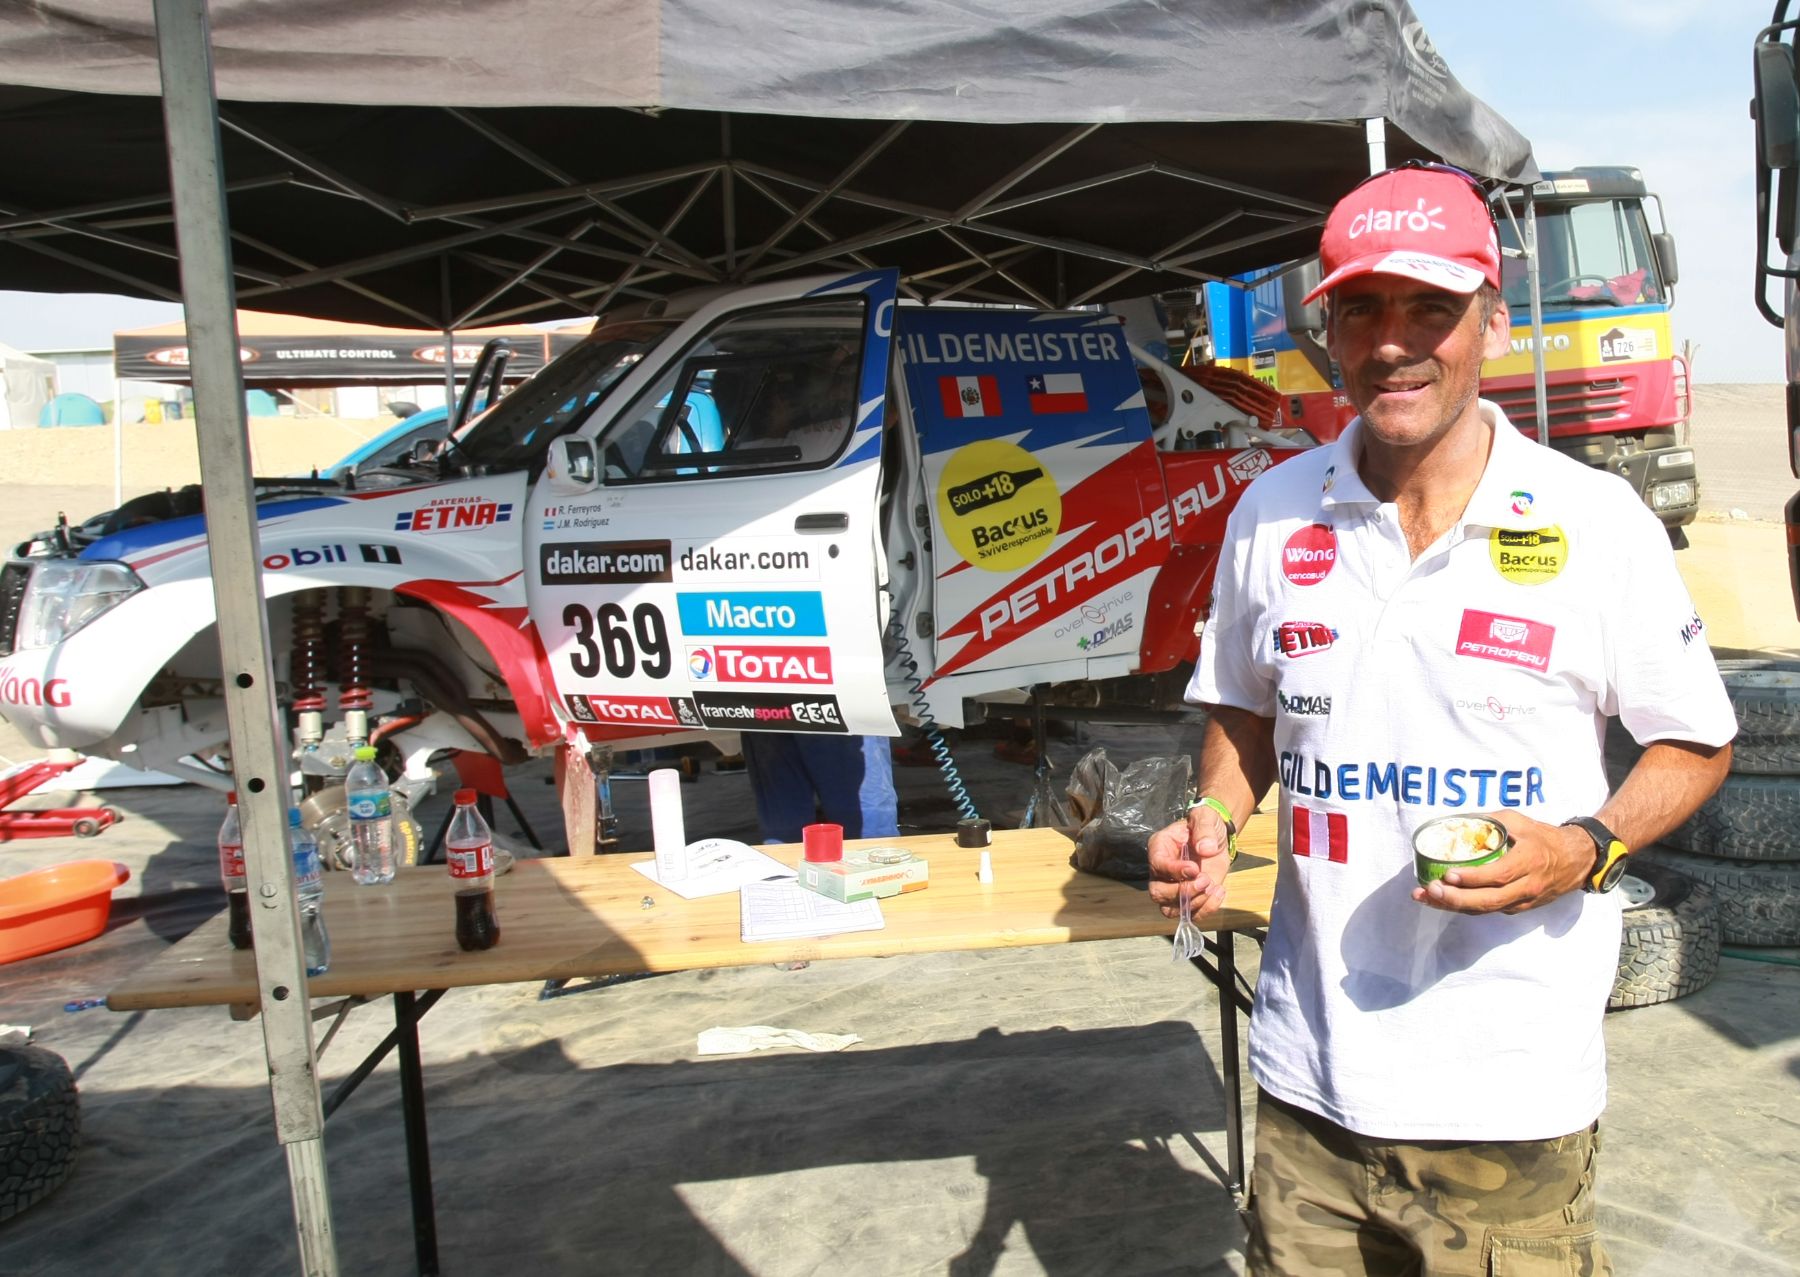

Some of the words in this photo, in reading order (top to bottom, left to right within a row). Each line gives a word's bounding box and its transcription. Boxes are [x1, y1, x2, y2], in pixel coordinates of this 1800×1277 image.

[1349, 207, 1431, 240] claro
[276, 349, 337, 360] ULTIMATE
[339, 349, 396, 359] CONTROL
[1511, 334, 1570, 353] VCO
[1617, 342, 1635, 353] 726
[430, 496, 483, 506] BATERIAS
[953, 489, 981, 508] SOLO
[982, 473, 1015, 499] +18
[411, 503, 498, 532] ETNA
[567, 504, 602, 515] Ferreyros
[971, 508, 1049, 549] Backus
[262, 544, 347, 570] obil
[546, 549, 665, 576] dakar.com
[680, 546, 810, 572] dakar.com
[979, 464, 1227, 642] PETROPERU
[1285, 547, 1335, 563] Wong
[706, 599, 797, 629] Macro
[562, 602, 672, 680] 369
[1279, 628, 1335, 654] ETNA
[1460, 641, 1547, 667] PETROPERU
[718, 649, 830, 681] TOTAL
[592, 699, 674, 721] TOTAL
[1279, 751, 1546, 808] GILDEMEISTER
